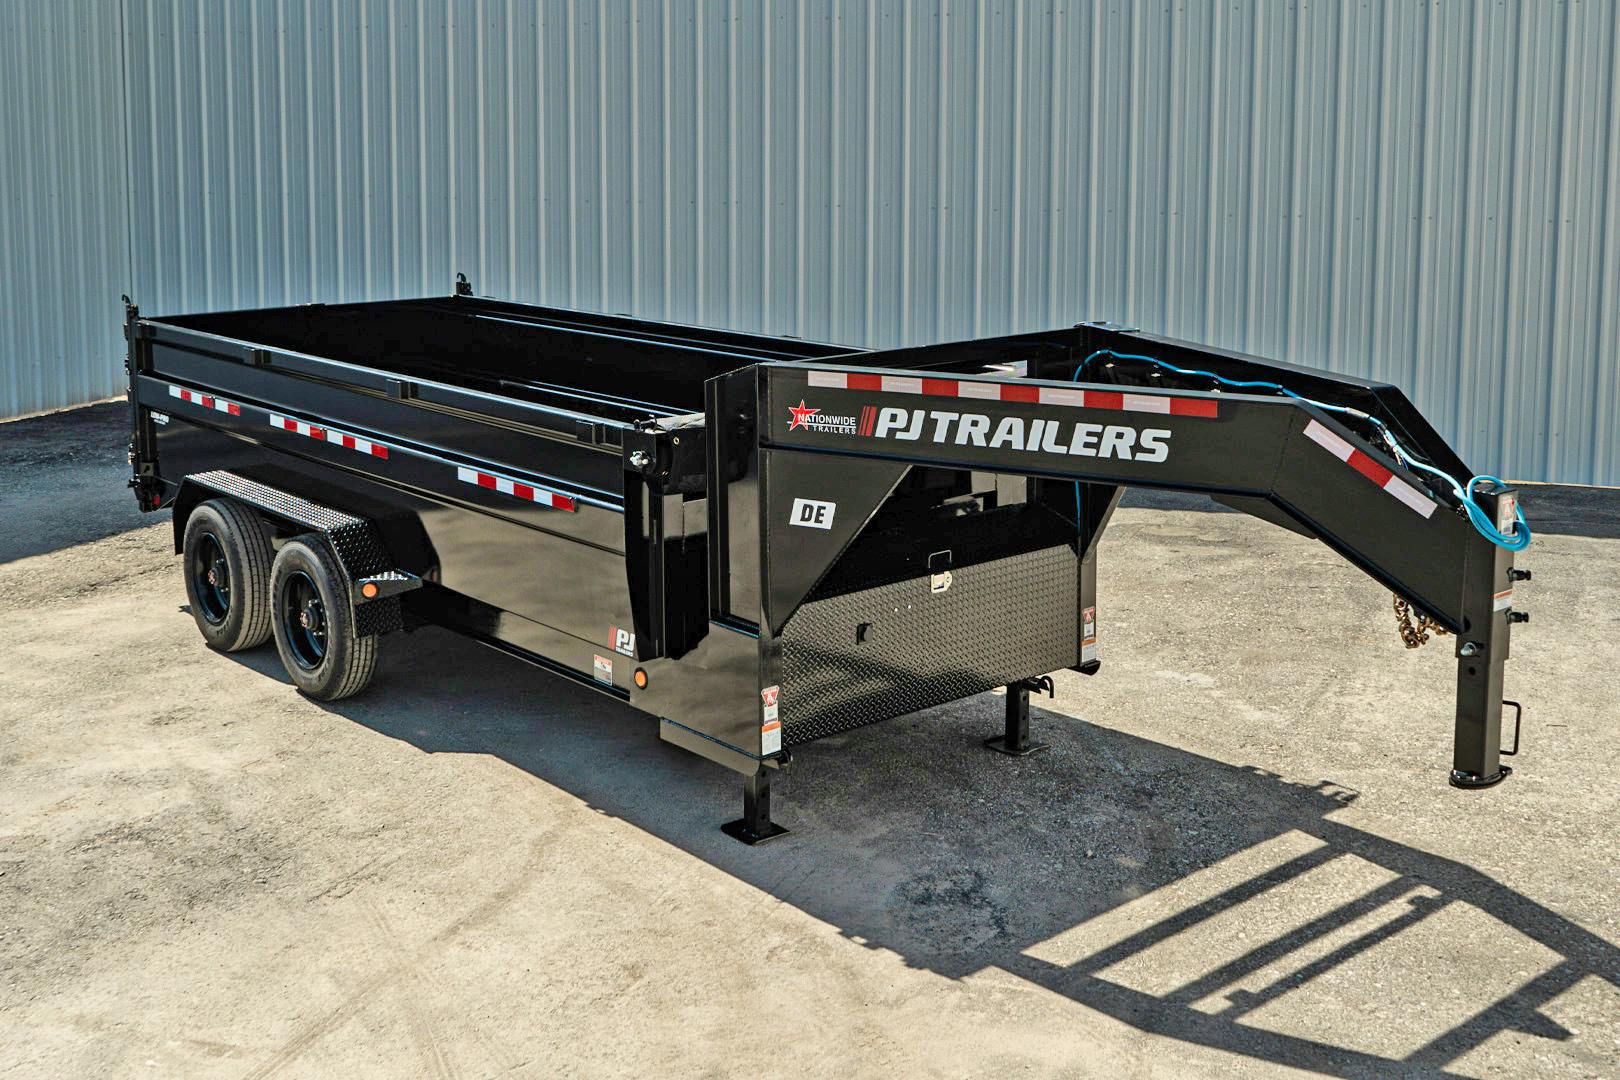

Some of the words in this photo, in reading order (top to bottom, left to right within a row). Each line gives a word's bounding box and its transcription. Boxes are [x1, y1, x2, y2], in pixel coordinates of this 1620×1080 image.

[797, 413, 857, 426] NATIONWIDE
[813, 425, 857, 435] TRAILERS
[875, 407, 925, 441] PJ
[930, 410, 1172, 463] TRAILERS
[800, 503, 827, 524] DE
[616, 629, 636, 651] PJ
